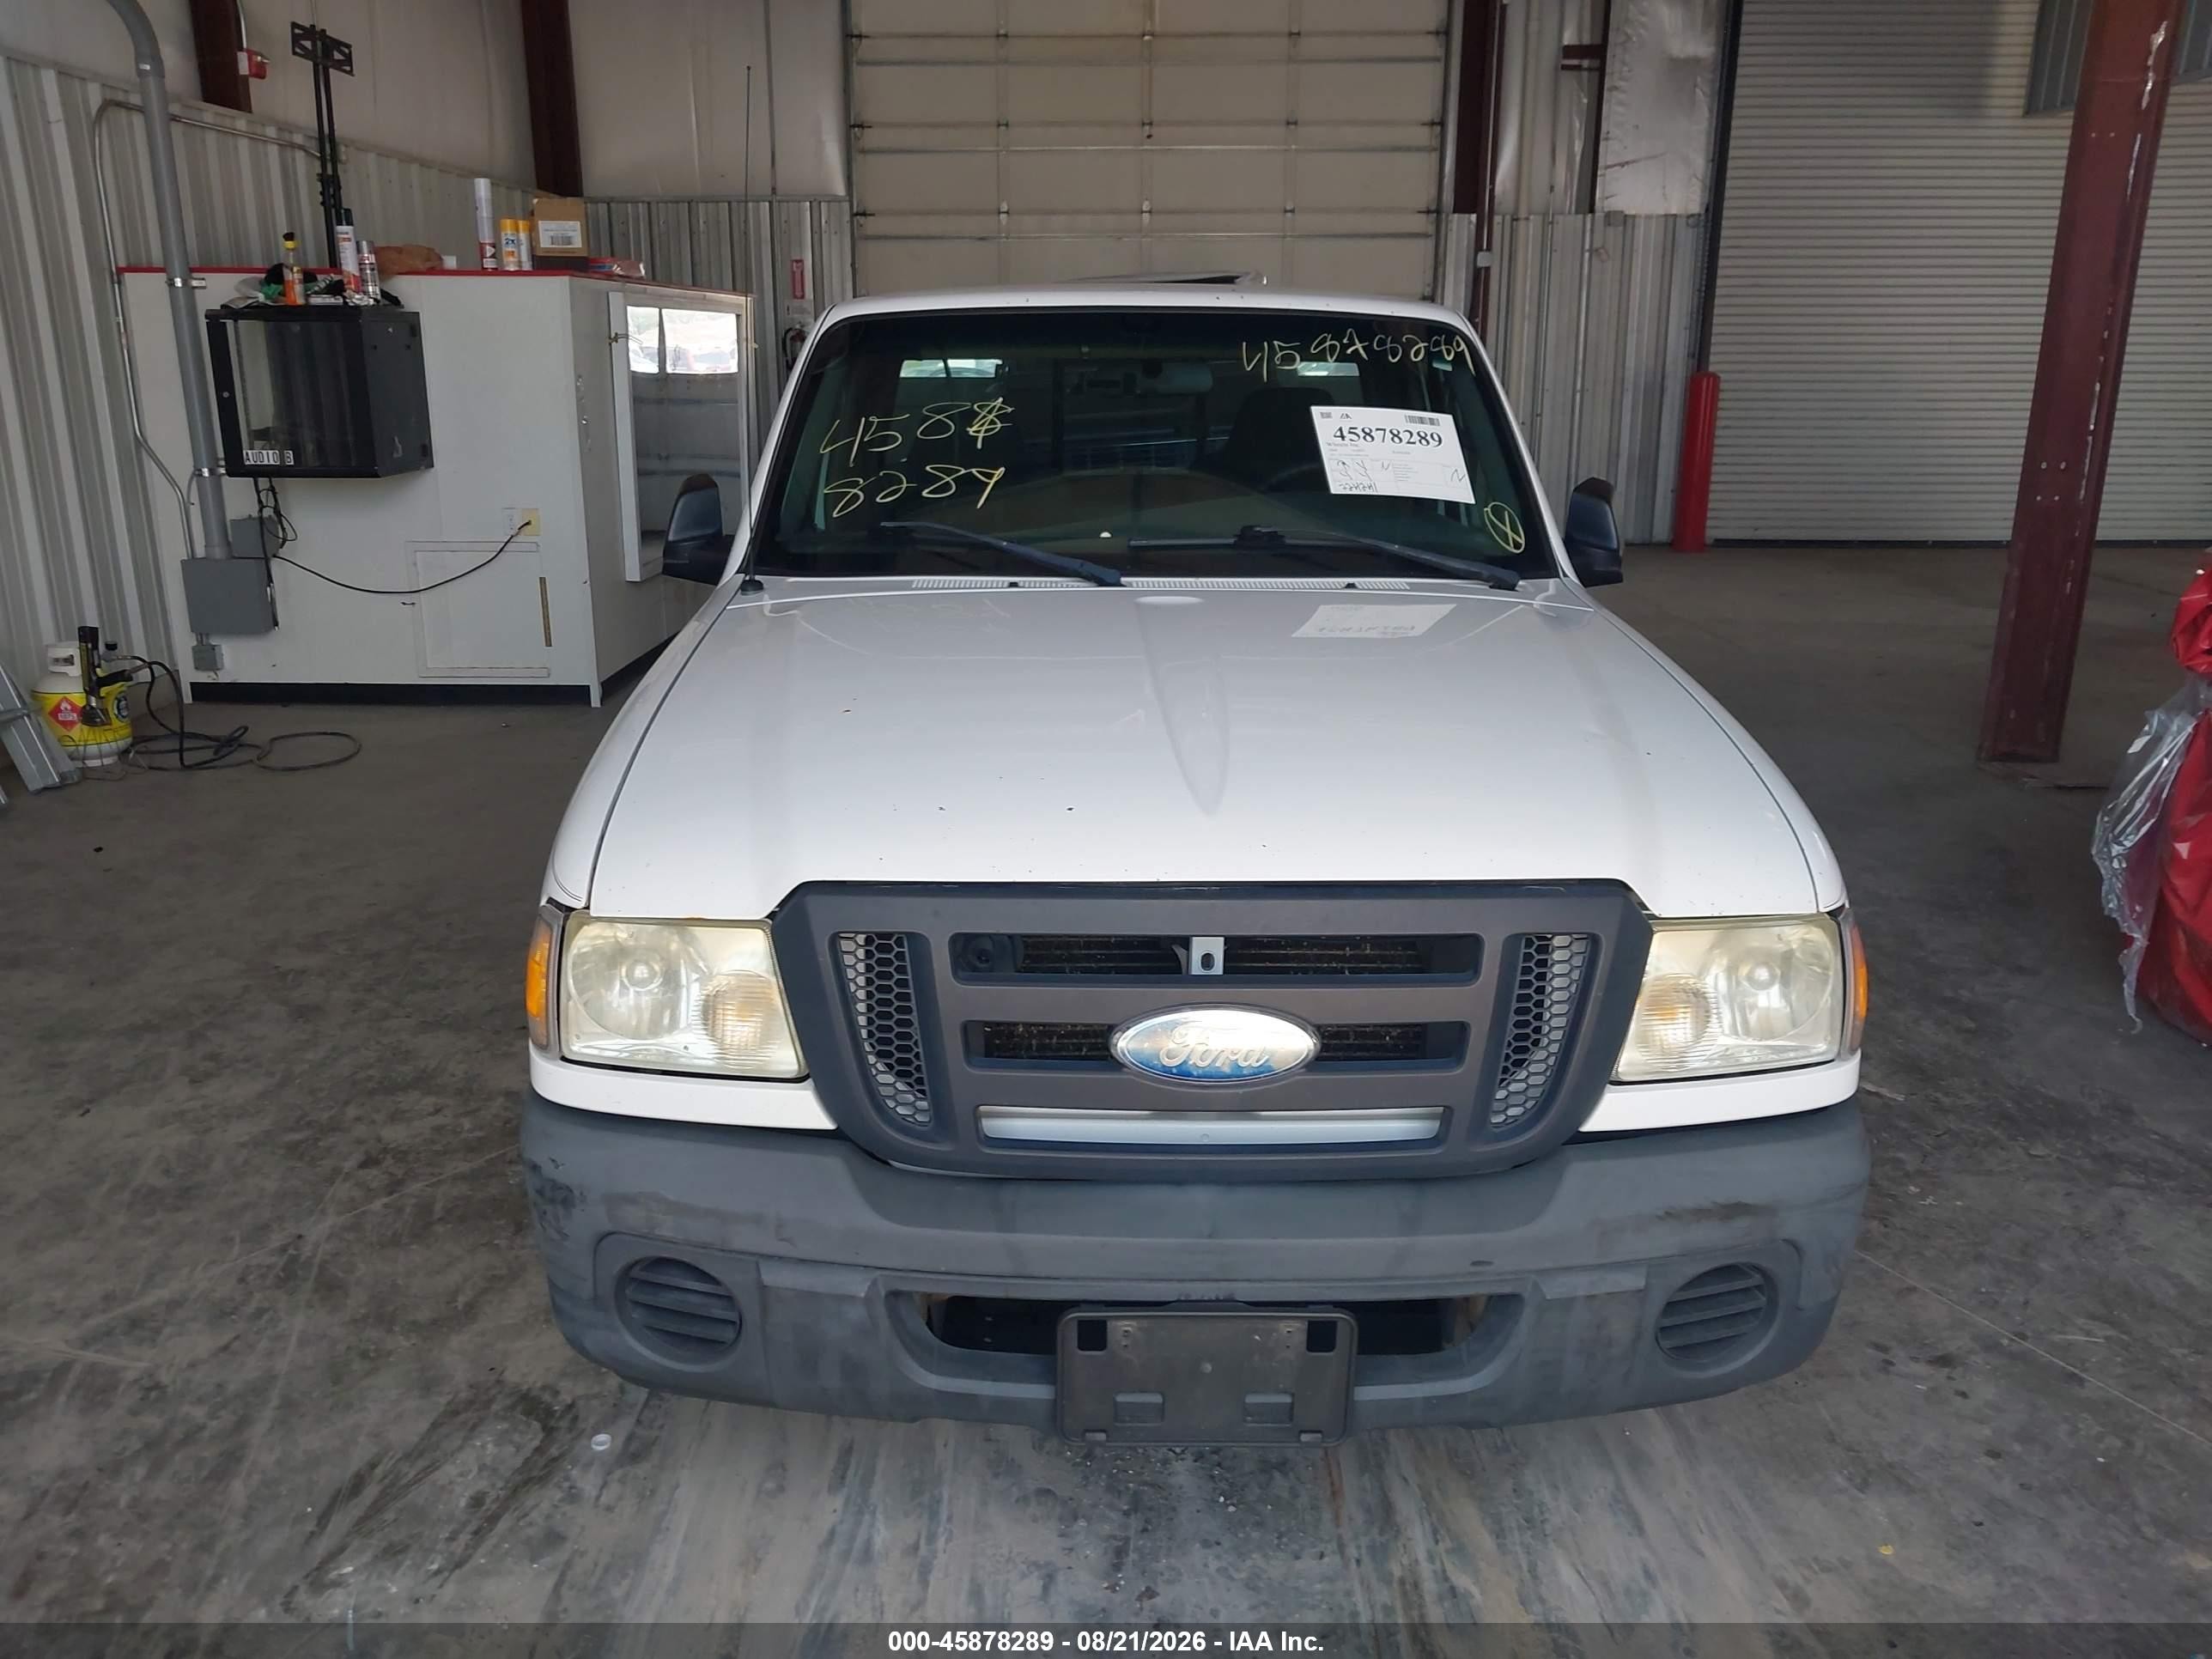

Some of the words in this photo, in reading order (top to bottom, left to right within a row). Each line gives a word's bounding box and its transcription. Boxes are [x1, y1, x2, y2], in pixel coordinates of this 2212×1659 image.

[1334, 426, 1443, 448] 45878289
[245, 451, 280, 463] AUDIO
[286, 451, 293, 463] B
[823, 464, 1006, 519] 8289
[1159, 1020, 1273, 1067] Ford
